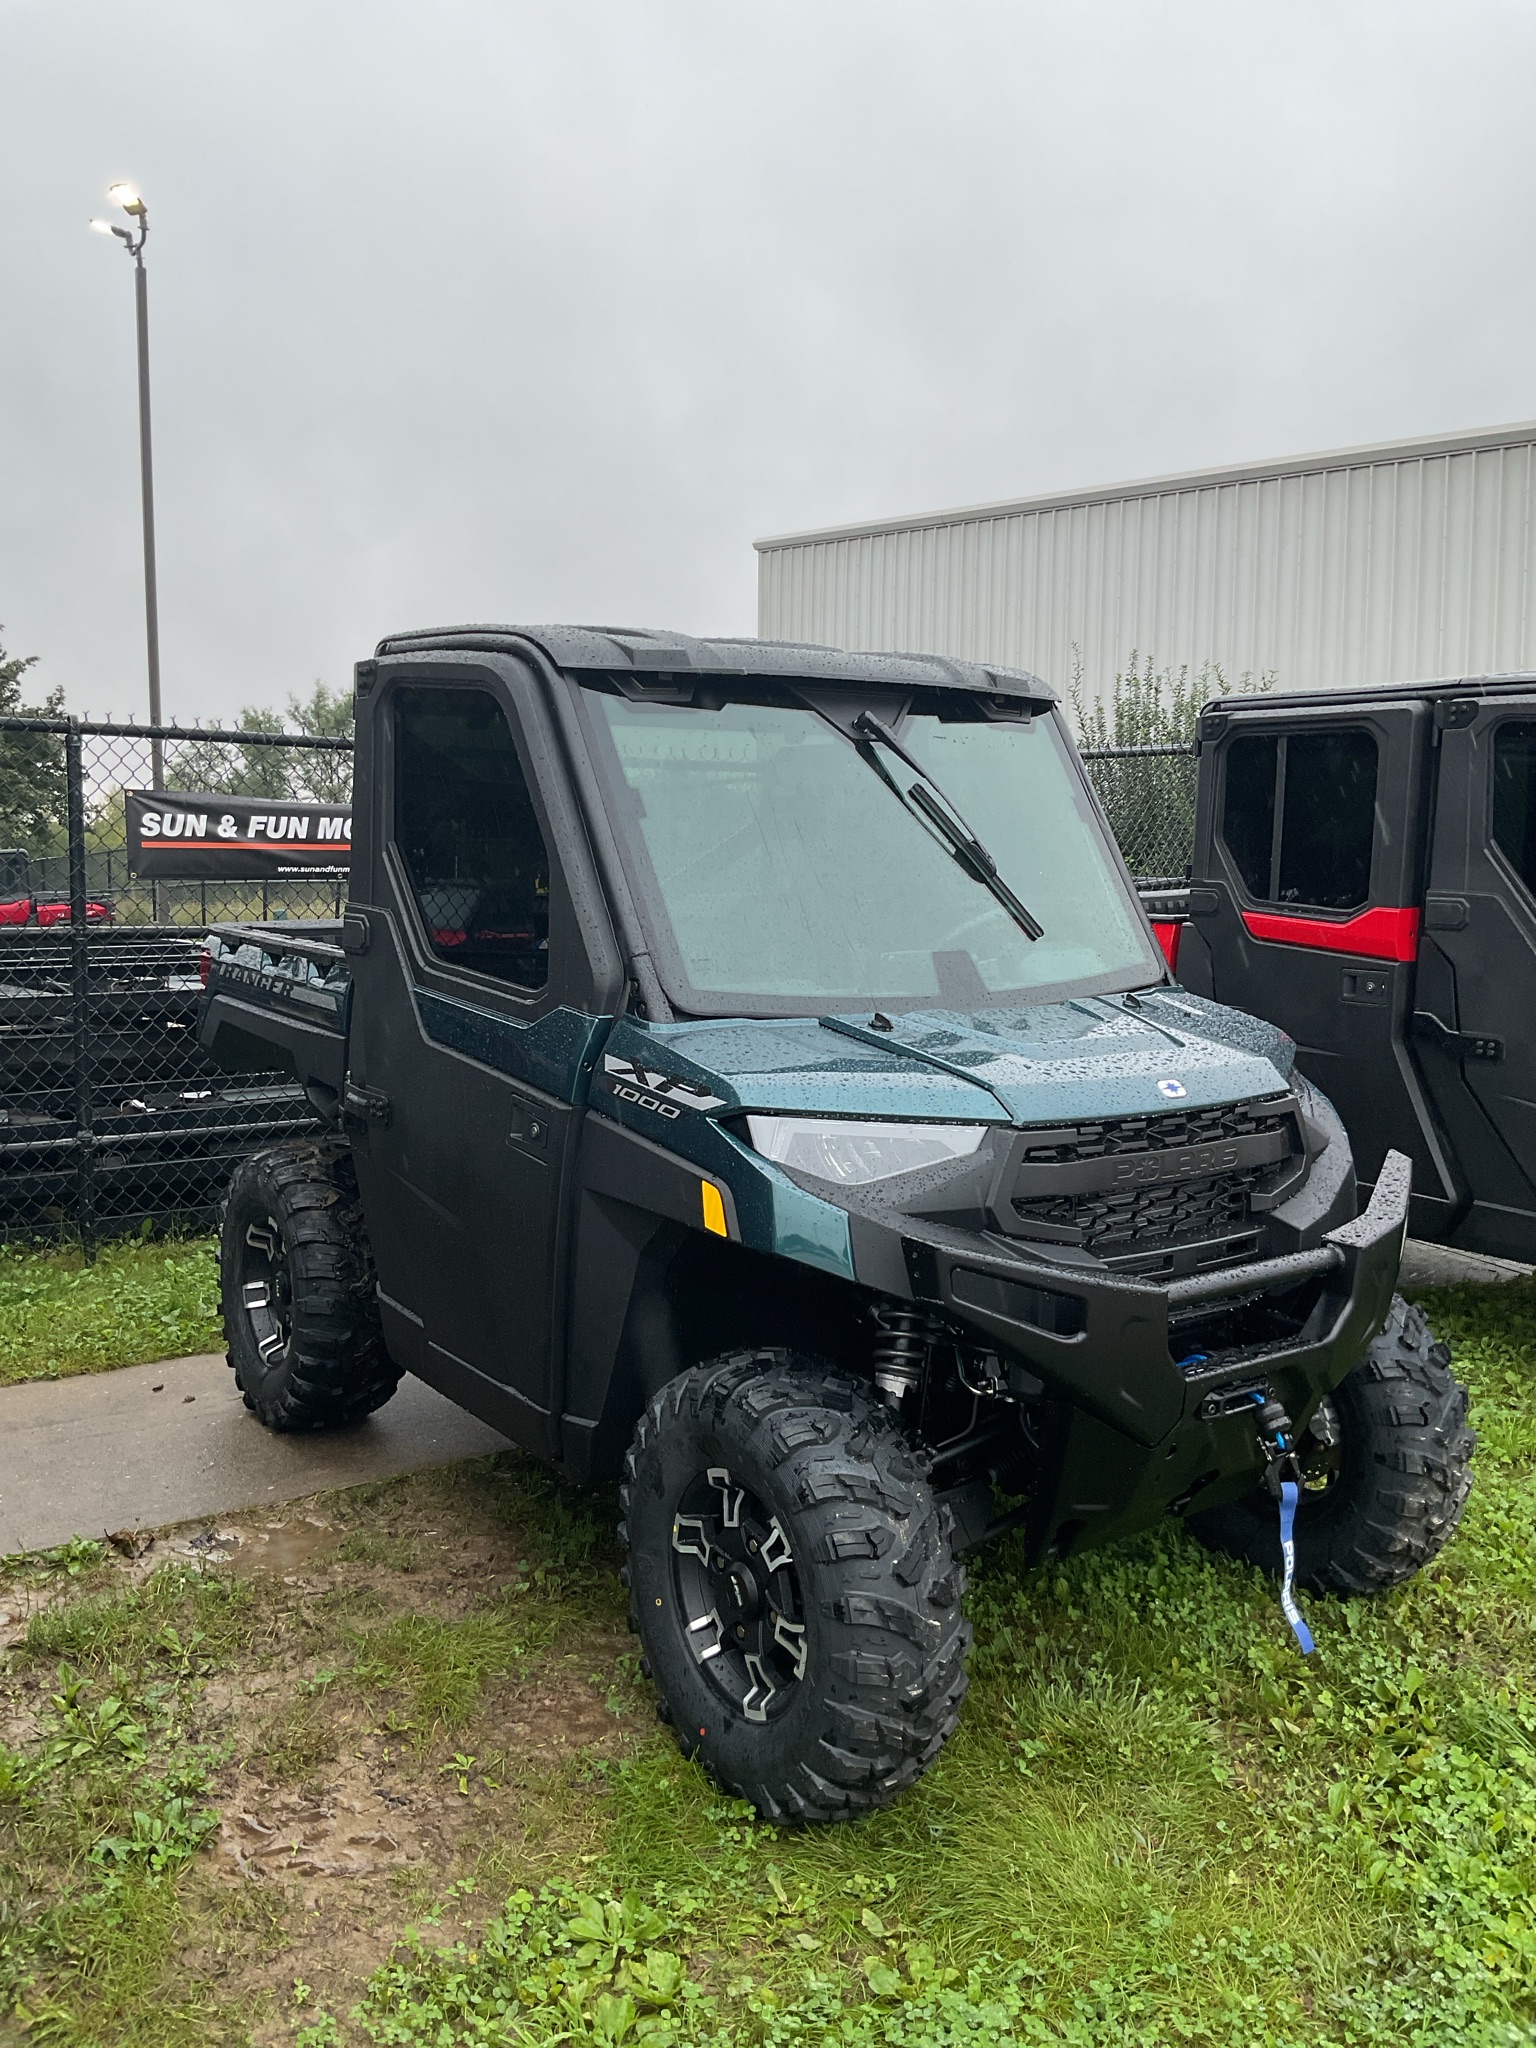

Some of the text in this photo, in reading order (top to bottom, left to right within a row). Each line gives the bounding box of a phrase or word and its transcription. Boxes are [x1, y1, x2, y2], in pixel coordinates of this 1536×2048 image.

[140, 812, 208, 838] SUN
[217, 814, 238, 838] &
[247, 815, 309, 839] FUN
[612, 1083, 681, 1119] 1000
[1282, 1540, 1300, 1625] POLARIS
